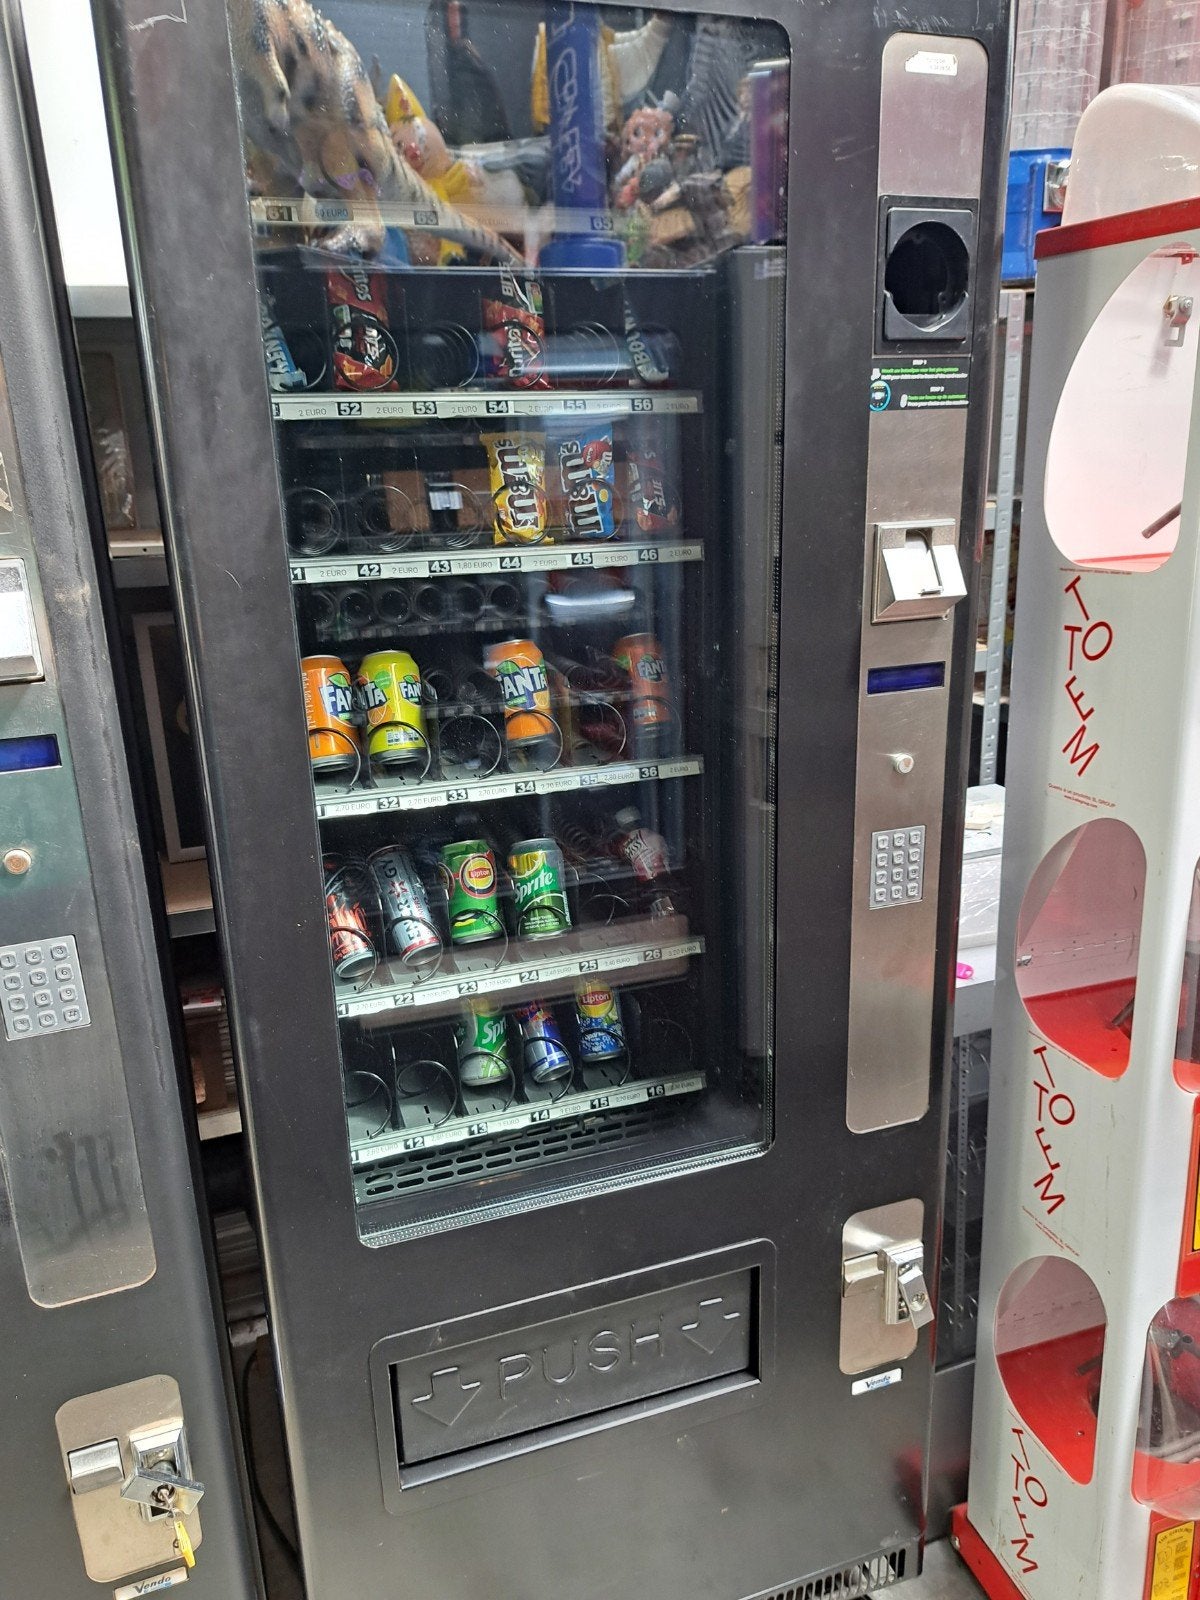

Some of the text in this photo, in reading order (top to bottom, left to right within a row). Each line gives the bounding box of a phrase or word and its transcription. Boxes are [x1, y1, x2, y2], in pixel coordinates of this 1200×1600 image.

[266, 205, 293, 221] 61
[326, 209, 349, 217] EURO
[415, 211, 438, 225] 63
[339, 402, 361, 415] 52
[382, 406, 404, 414] EURO
[415, 402, 436, 414] 53
[452, 405, 478, 414] 2 EURO
[488, 401, 509, 413] 54
[528, 405, 553, 413] 2 EURO
[566, 399, 586, 411] 55
[634, 398, 652, 411] 56
[305, 408, 327, 416] EURO
[573, 553, 592, 564] 45
[610, 555, 629, 563] EURO
[640, 549, 658, 561] 46
[430, 561, 450, 573] 43
[457, 561, 493, 570] 1,80 EURO
[501, 557, 521, 569] 44
[326, 569, 347, 577] EURO
[360, 564, 380, 577] 42
[1062, 574, 1113, 777] TOTEM
[618, 772, 635, 780] EURO
[641, 767, 658, 778] 36
[556, 779, 573, 789] EURO
[582, 775, 598, 785] 35
[492, 787, 507, 795] EURO
[517, 782, 535, 793] 34
[448, 789, 467, 800] 33
[379, 797, 399, 809] 32
[423, 796, 443, 805] EURO
[351, 802, 371, 811] EURO
[514, 869, 554, 904] Sprite
[645, 950, 661, 961] 26
[581, 961, 598, 972] 25
[520, 971, 539, 982] 24
[459, 982, 477, 993] 23
[394, 994, 414, 1005] 22
[582, 993, 610, 1005] Lipton
[649, 1085, 664, 1097] 16
[592, 1097, 609, 1109] 15
[565, 1105, 581, 1113] EURO
[532, 1110, 550, 1121] 14
[503, 1118, 520, 1126] EURO
[444, 1130, 462, 1139] EURO
[471, 1123, 488, 1135] 13
[1033, 1045, 1076, 1216] TOTEM
[406, 1137, 425, 1149] 12
[499, 1313, 665, 1400] PUSH
[865, 1376, 891, 1388] Vendo
[1011, 1427, 1048, 1574] TOTEM
[133, 1576, 171, 1594] Vendo
